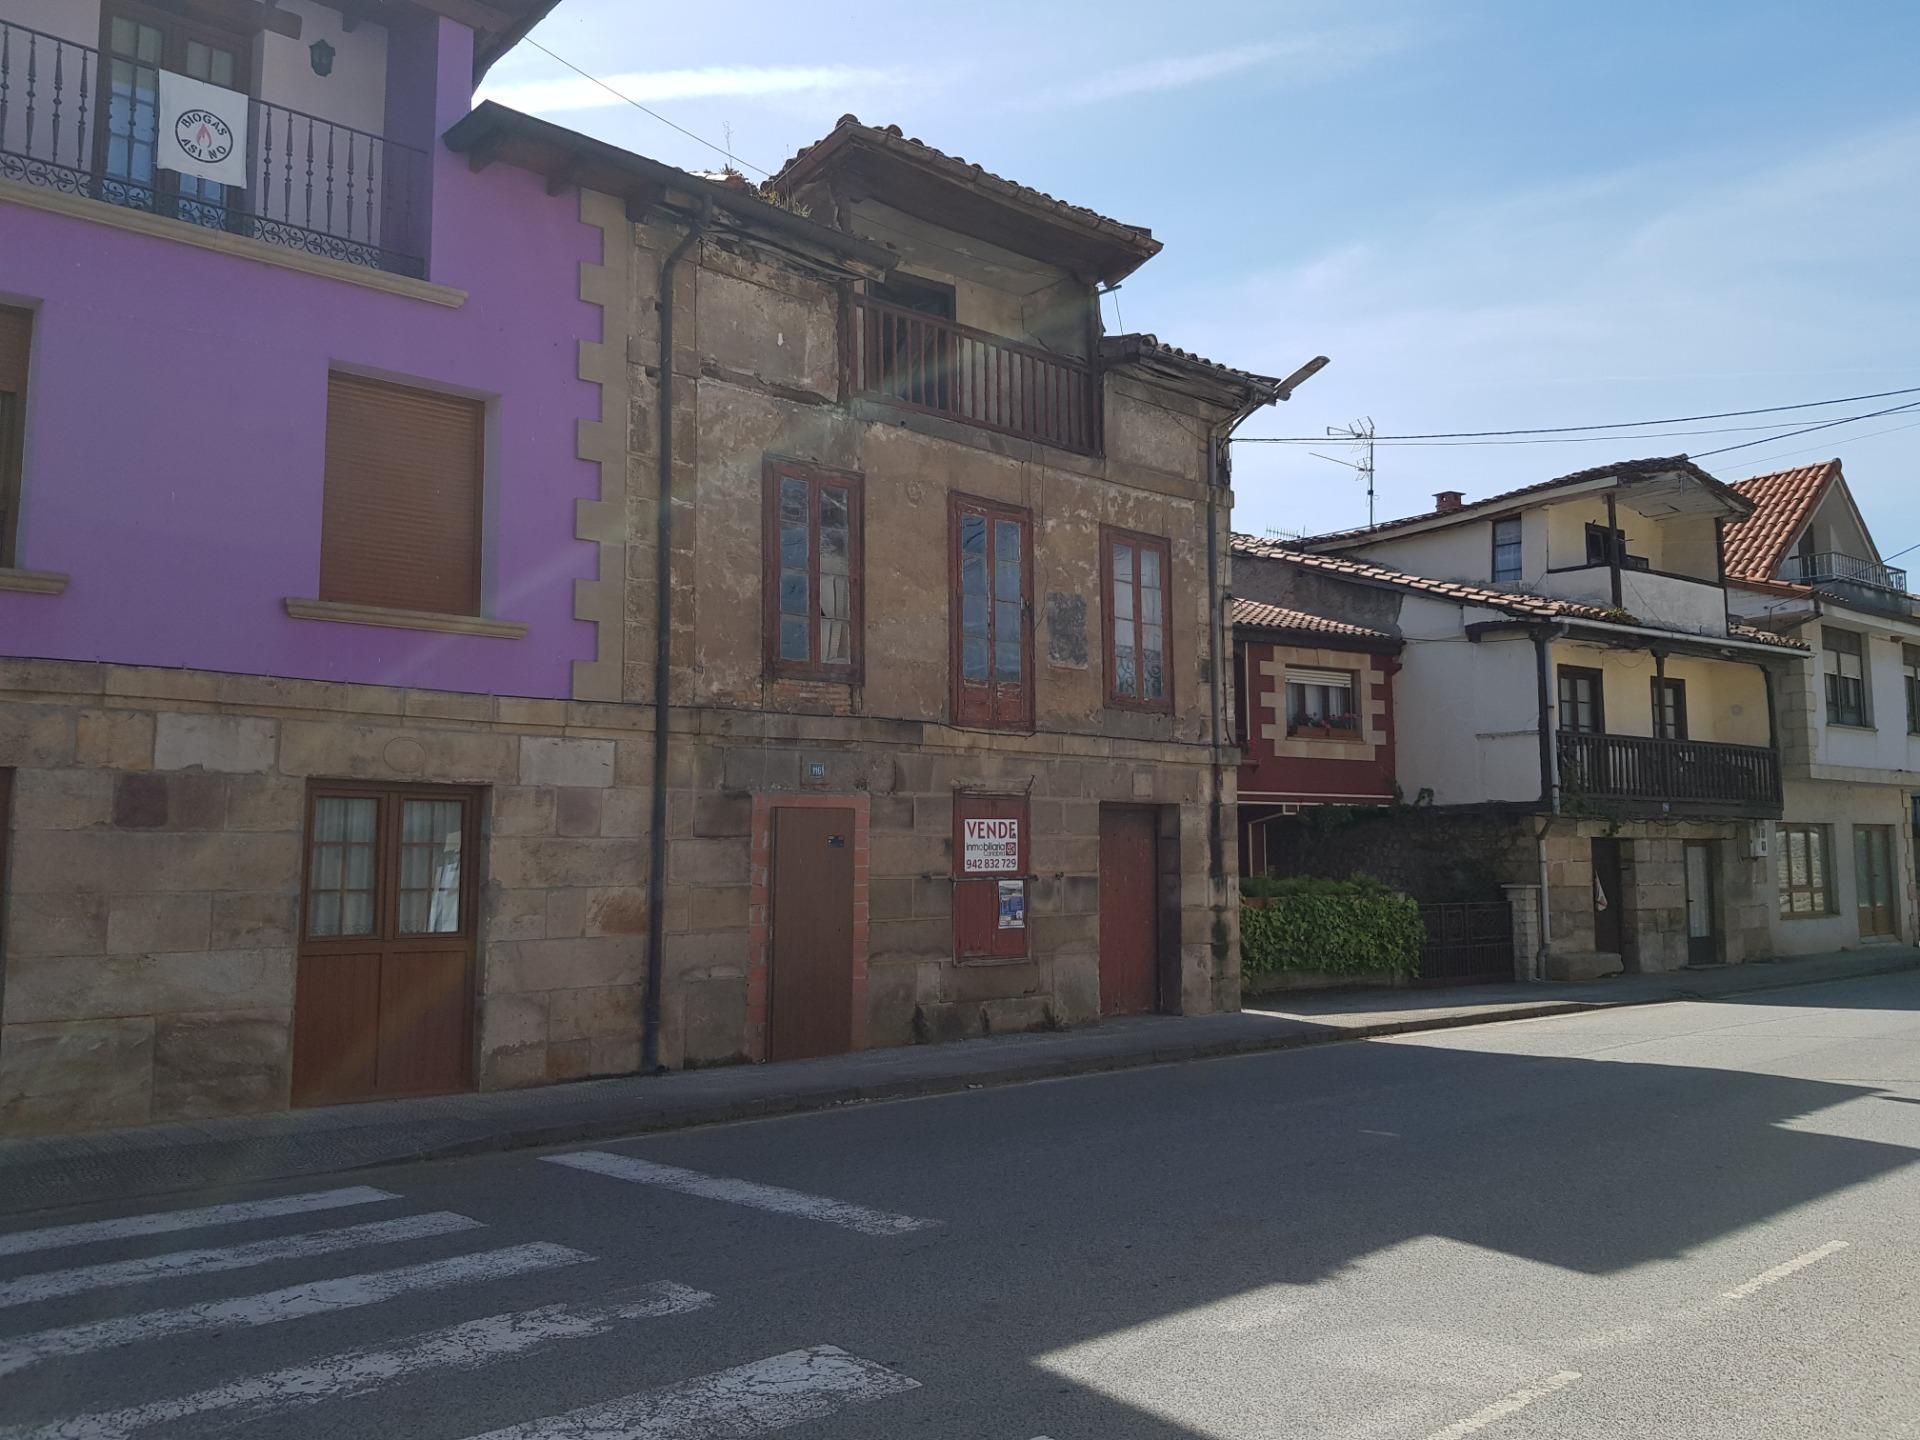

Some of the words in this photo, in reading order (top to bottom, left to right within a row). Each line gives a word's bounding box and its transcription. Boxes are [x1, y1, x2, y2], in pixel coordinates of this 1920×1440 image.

[181, 112, 227, 136] BIOGAS
[181, 138, 202, 158] ASI
[208, 145, 227, 160] NO
[966, 821, 1017, 839] VENDE
[966, 859, 983, 869] 942
[984, 858, 1000, 869] 832
[1001, 858, 1017, 869] 729
